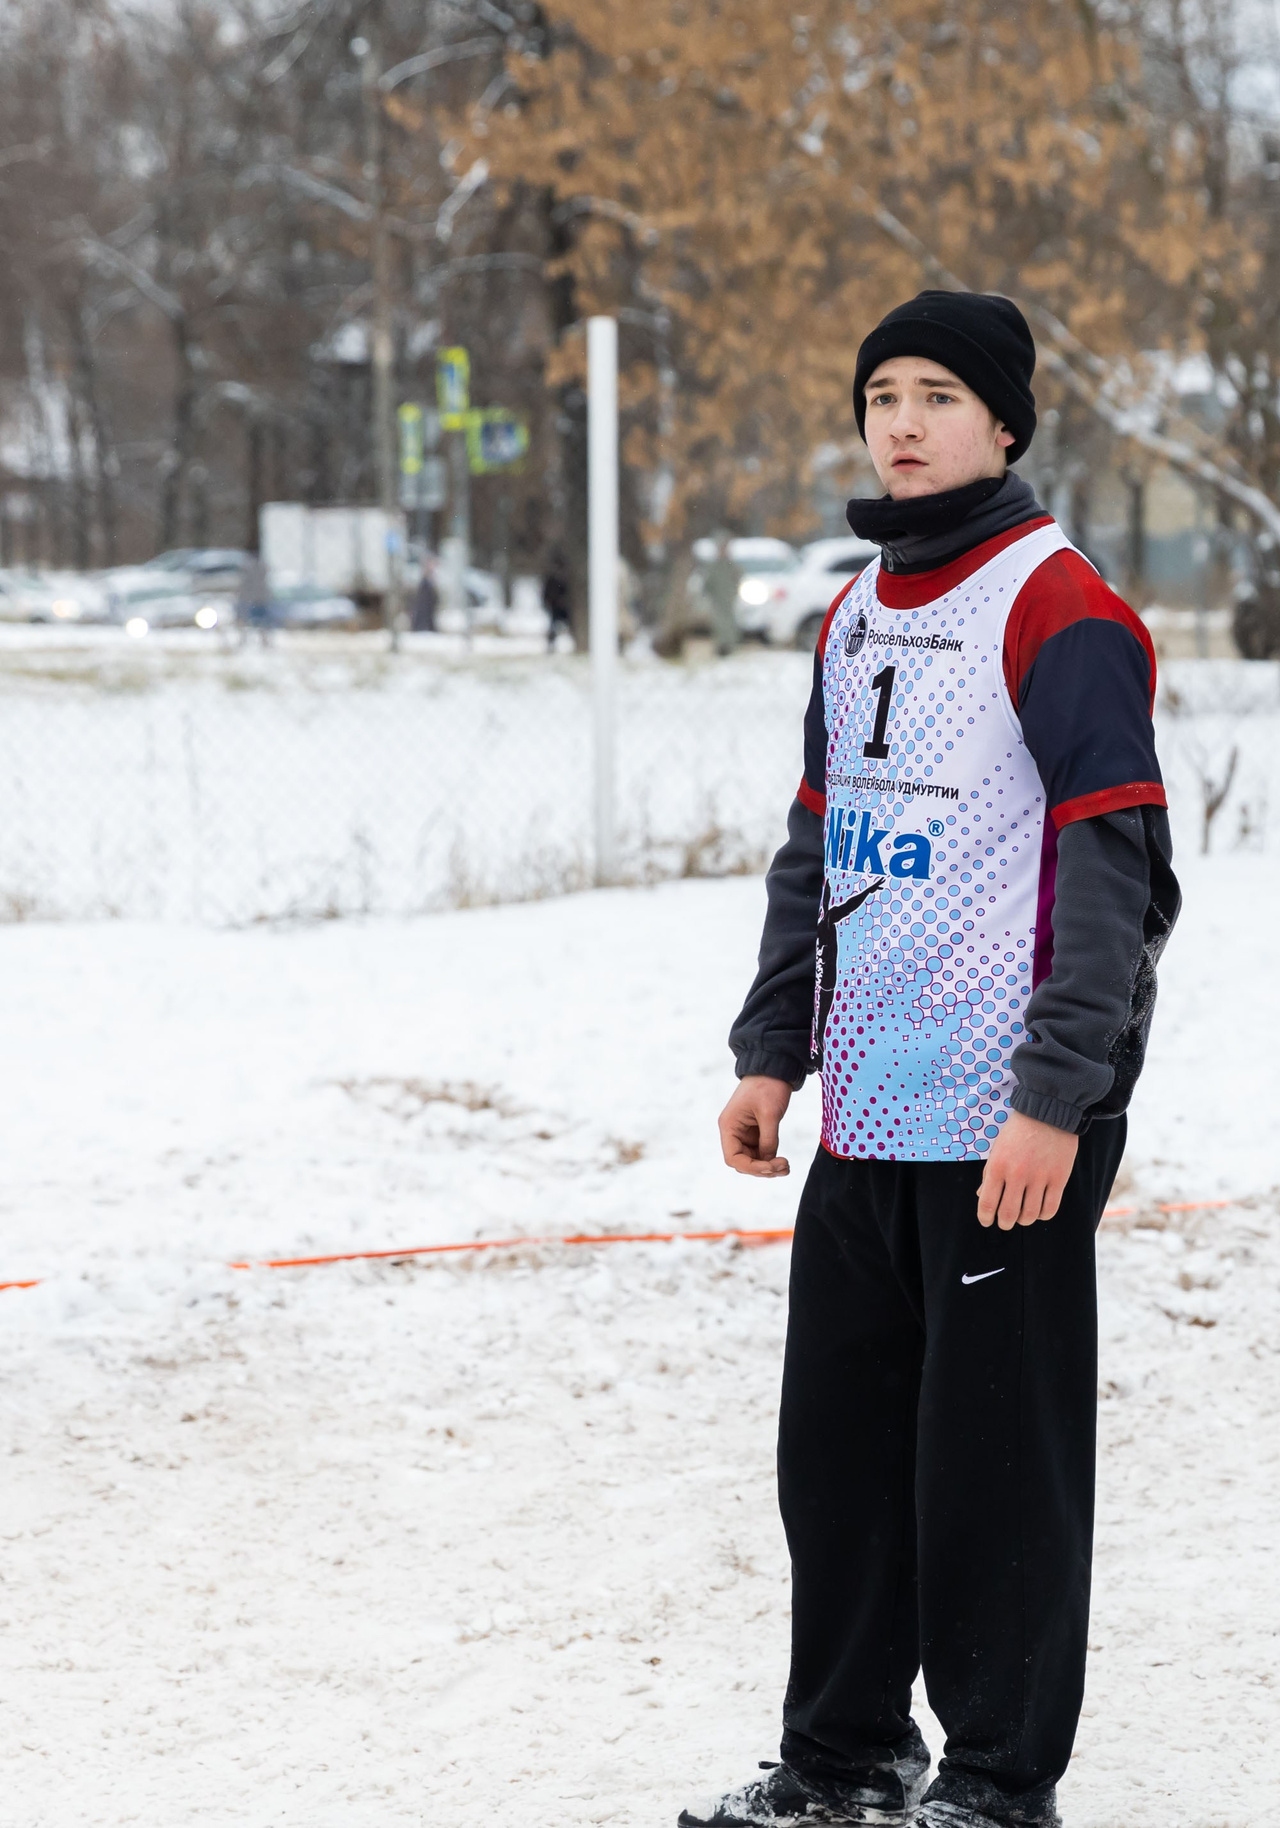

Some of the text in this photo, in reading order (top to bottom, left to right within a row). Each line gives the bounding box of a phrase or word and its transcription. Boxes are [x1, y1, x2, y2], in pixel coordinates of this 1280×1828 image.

[867, 629, 964, 652] РоссельхозБанк
[863, 665, 896, 759] 1
[852, 776, 896, 793] ВОЛЕЙБОЛА
[898, 781, 960, 800] УДМУРТИИ
